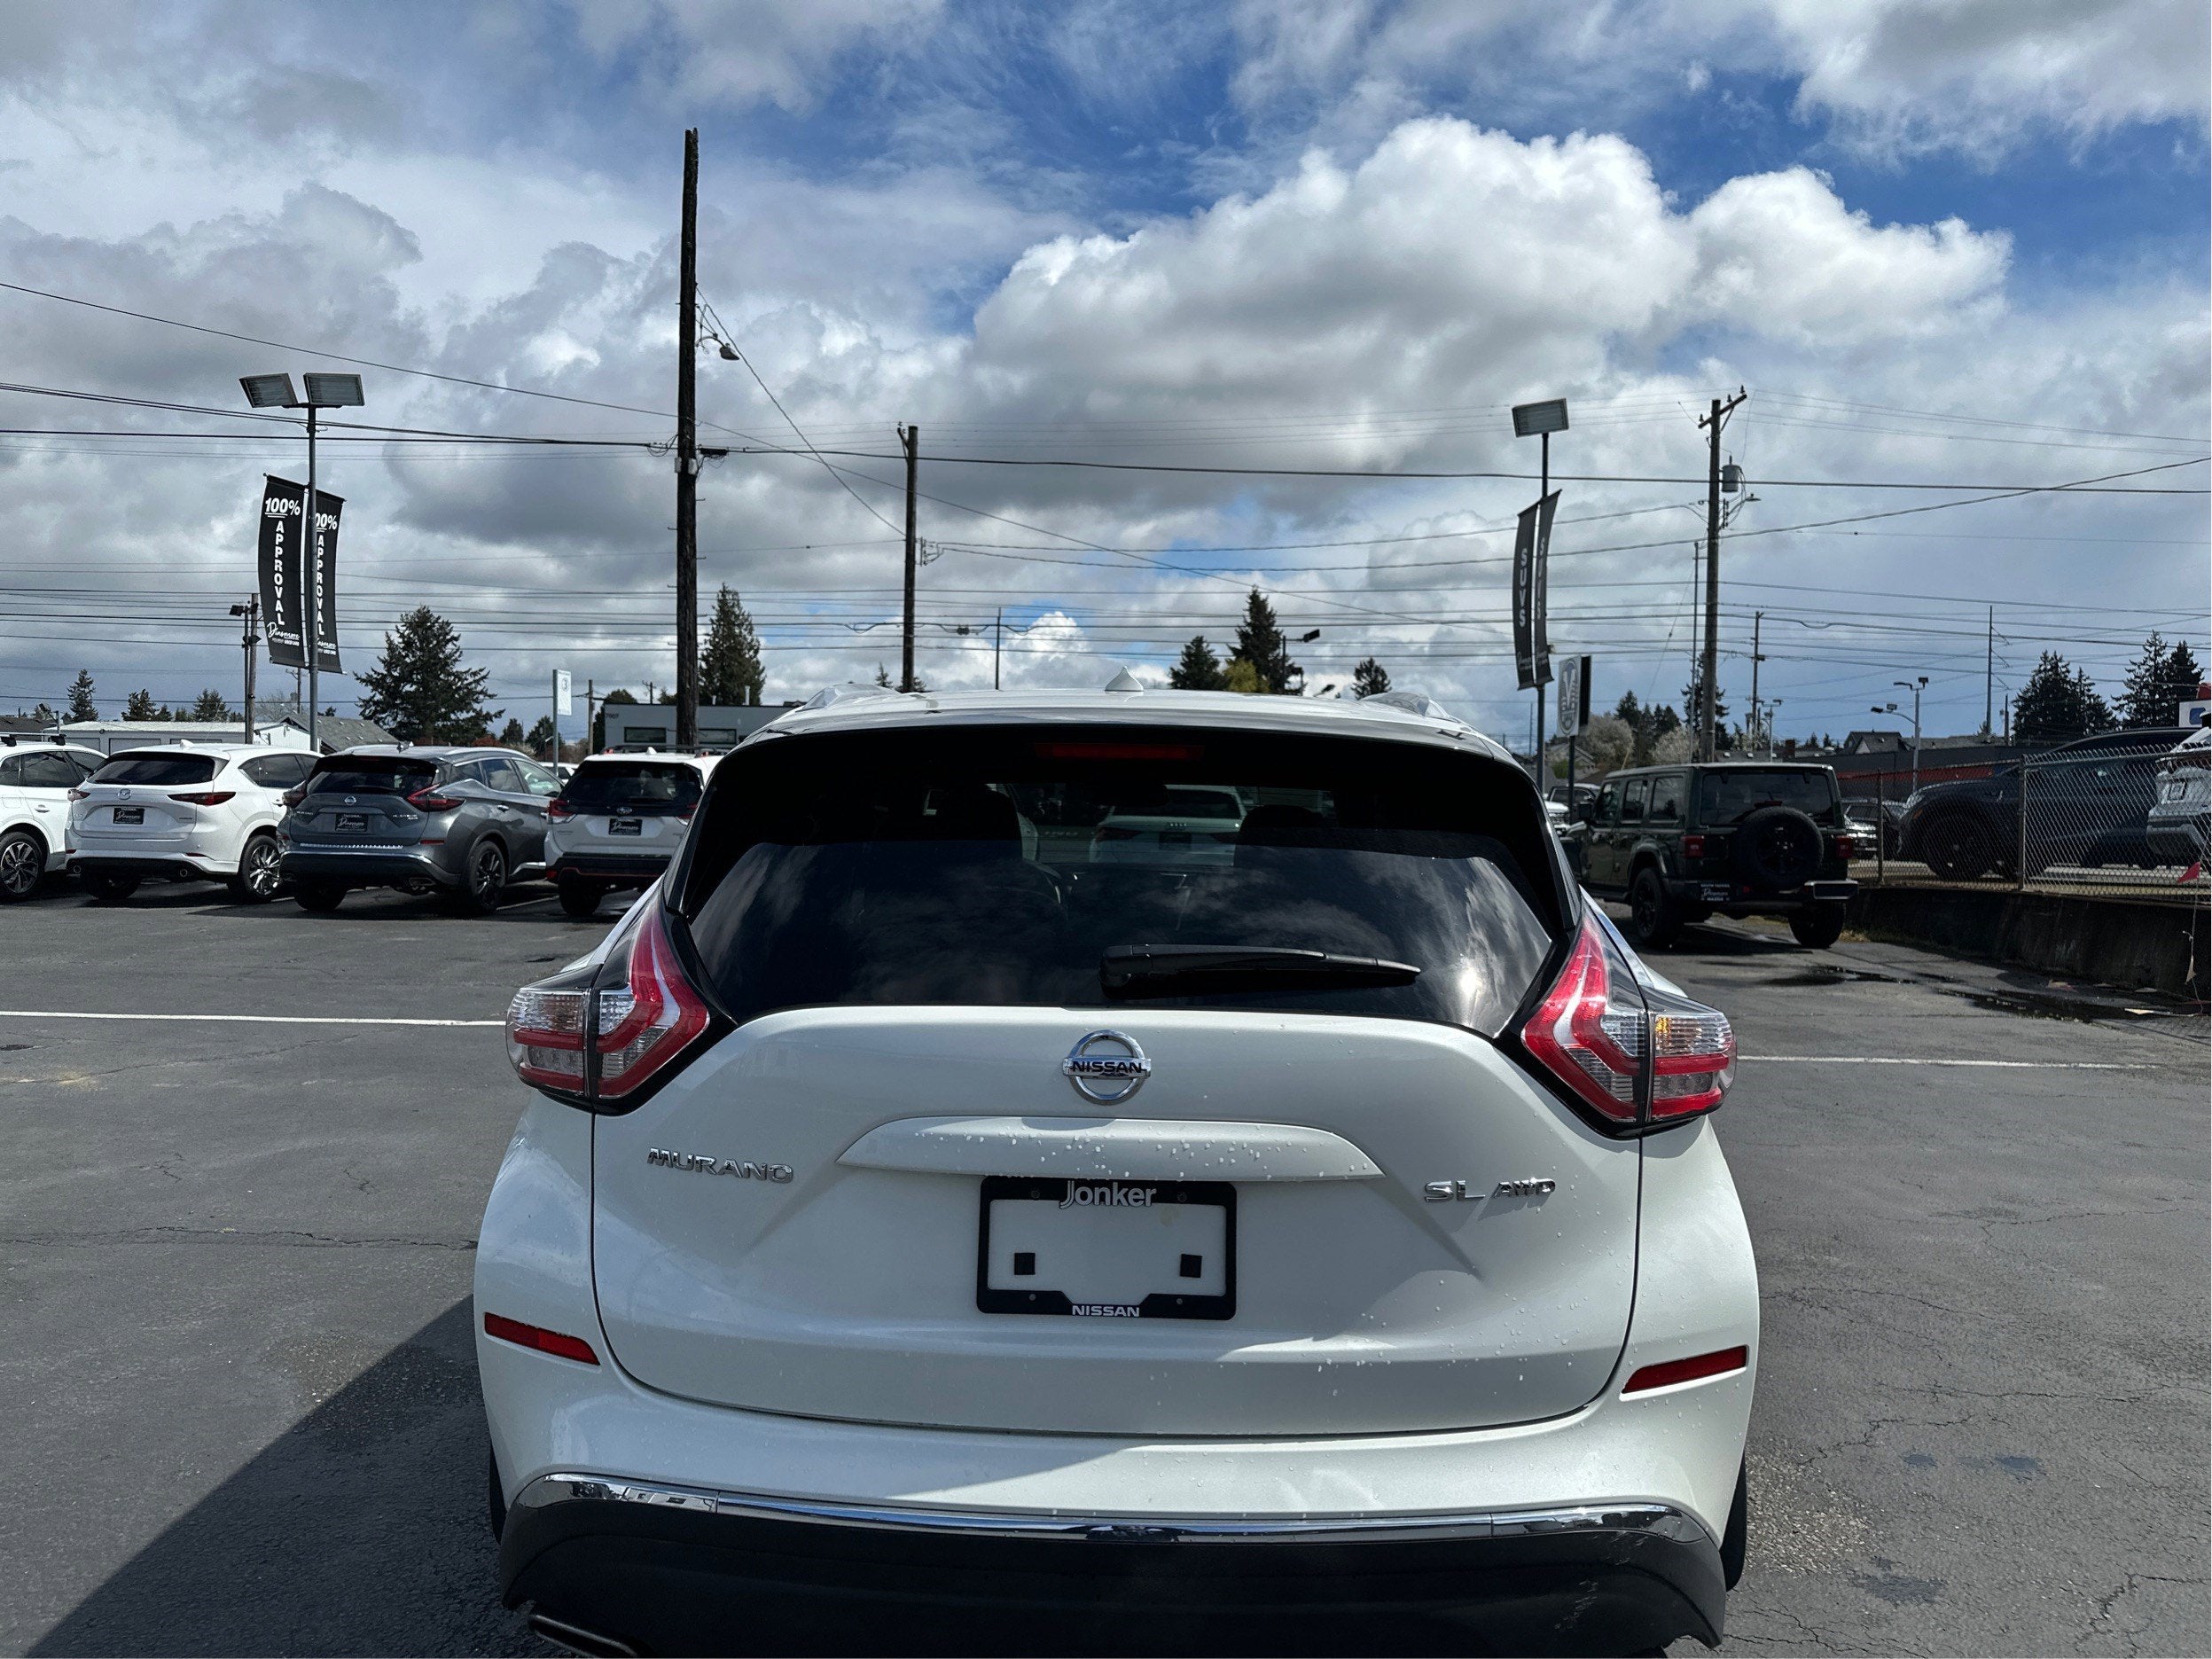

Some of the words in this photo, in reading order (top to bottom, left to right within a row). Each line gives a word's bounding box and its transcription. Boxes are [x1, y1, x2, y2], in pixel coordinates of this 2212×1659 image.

[265, 497, 301, 515] 100%
[316, 513, 337, 529] 00%
[274, 520, 285, 626] APPROVAL
[1519, 547, 1528, 629] SUVS
[1071, 1060, 1142, 1073] NISSAN
[646, 1147, 793, 1185] MURANO
[1059, 1180, 1157, 1209] Jonker
[1424, 1180, 1485, 1202] SL
[1490, 1178, 1556, 1197] AWD
[1072, 1305, 1140, 1317] NISSAN
